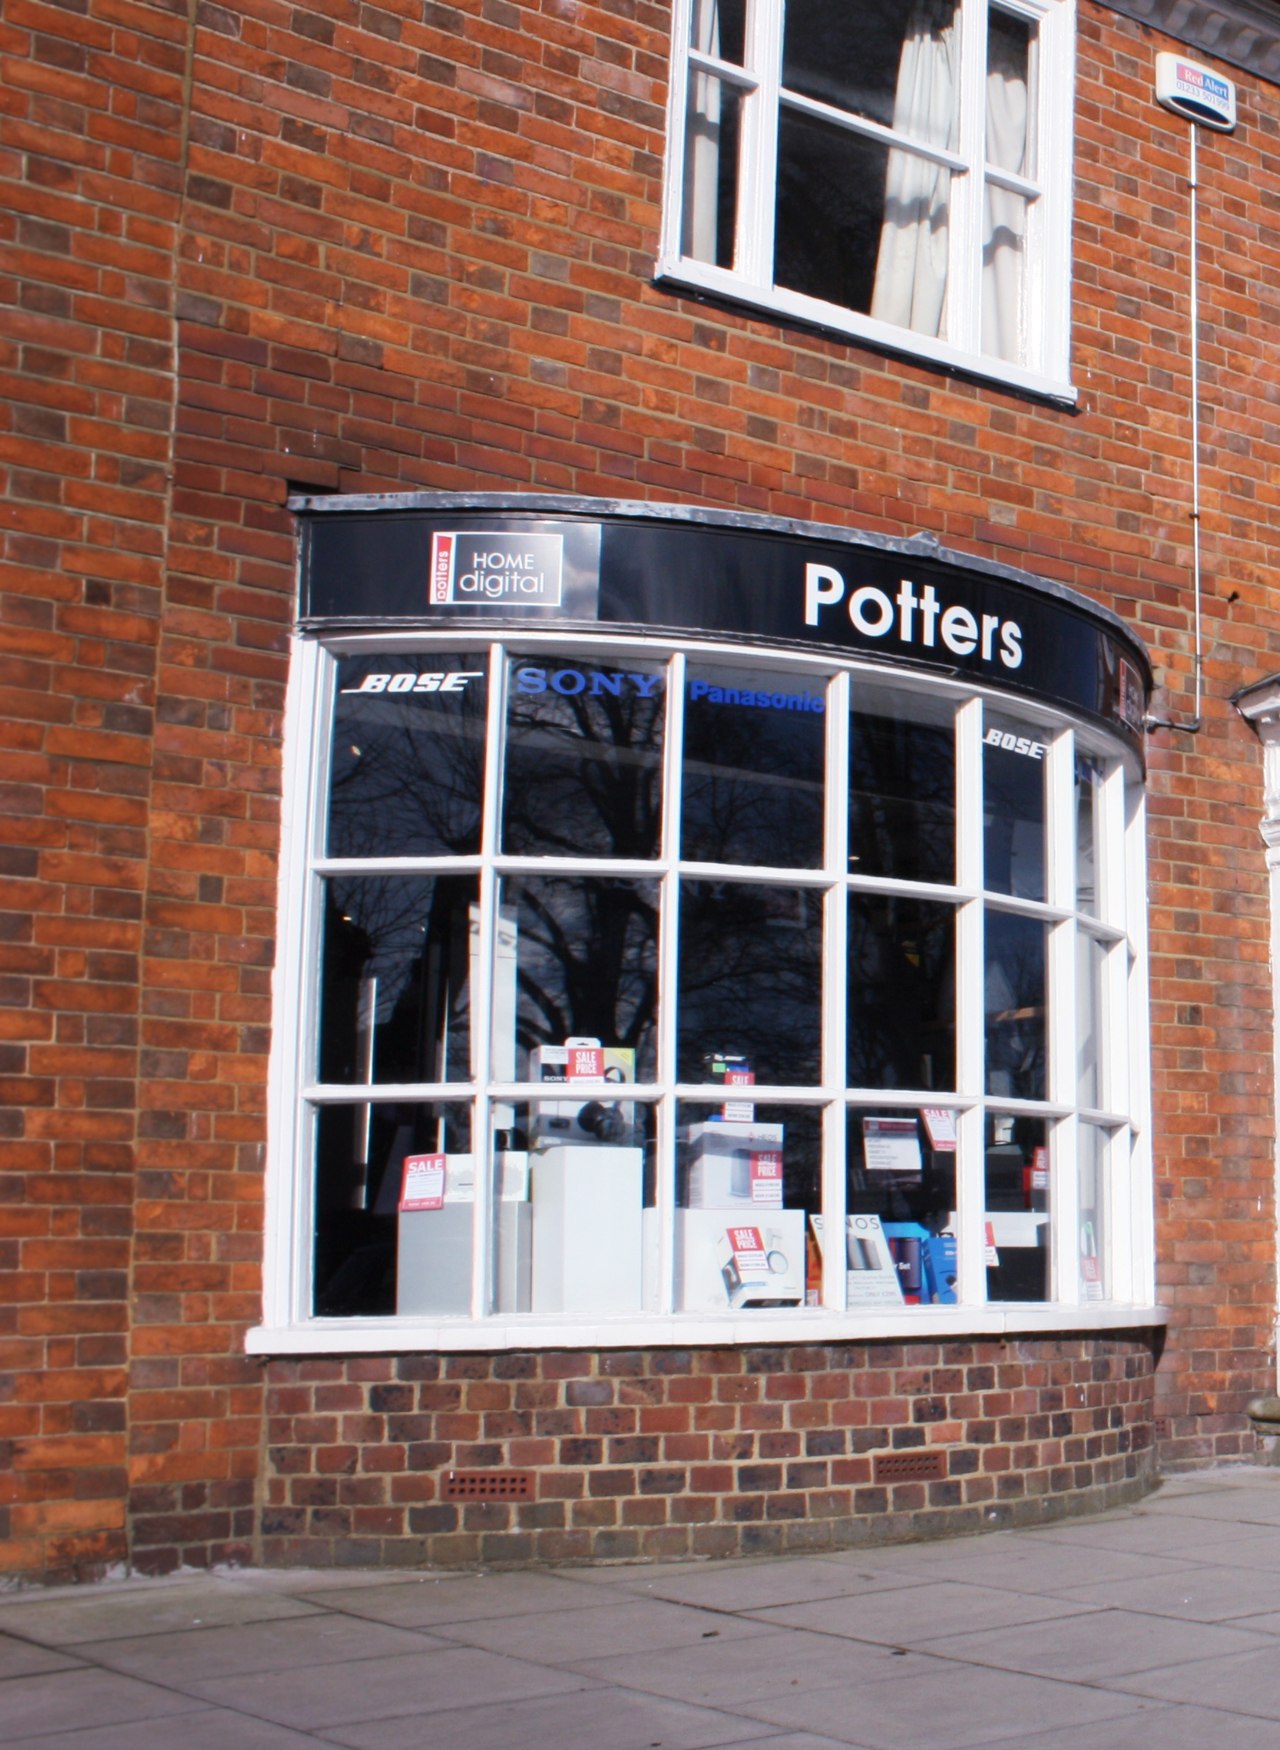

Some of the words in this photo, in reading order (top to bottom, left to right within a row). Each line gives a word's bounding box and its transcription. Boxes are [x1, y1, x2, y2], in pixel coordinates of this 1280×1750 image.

[1184, 69, 1203, 89] Red
[1204, 77, 1228, 98] Alert
[473, 552, 535, 570] HOME
[460, 570, 545, 598] digital
[804, 562, 1023, 669] Potters
[341, 671, 484, 695] BOSE
[516, 667, 663, 698] SONY
[690, 680, 825, 713] Panasonic
[982, 728, 1048, 760] BOSE
[575, 1051, 596, 1063] SALE
[575, 1063, 597, 1074] PRICE
[408, 1158, 444, 1174] SALE
[758, 1153, 777, 1165] SALE
[757, 1165, 777, 1177] PRICE
[814, 1217, 880, 1230] SOS
[733, 1229, 754, 1240] SALE
[736, 1238, 758, 1249] PRICE
